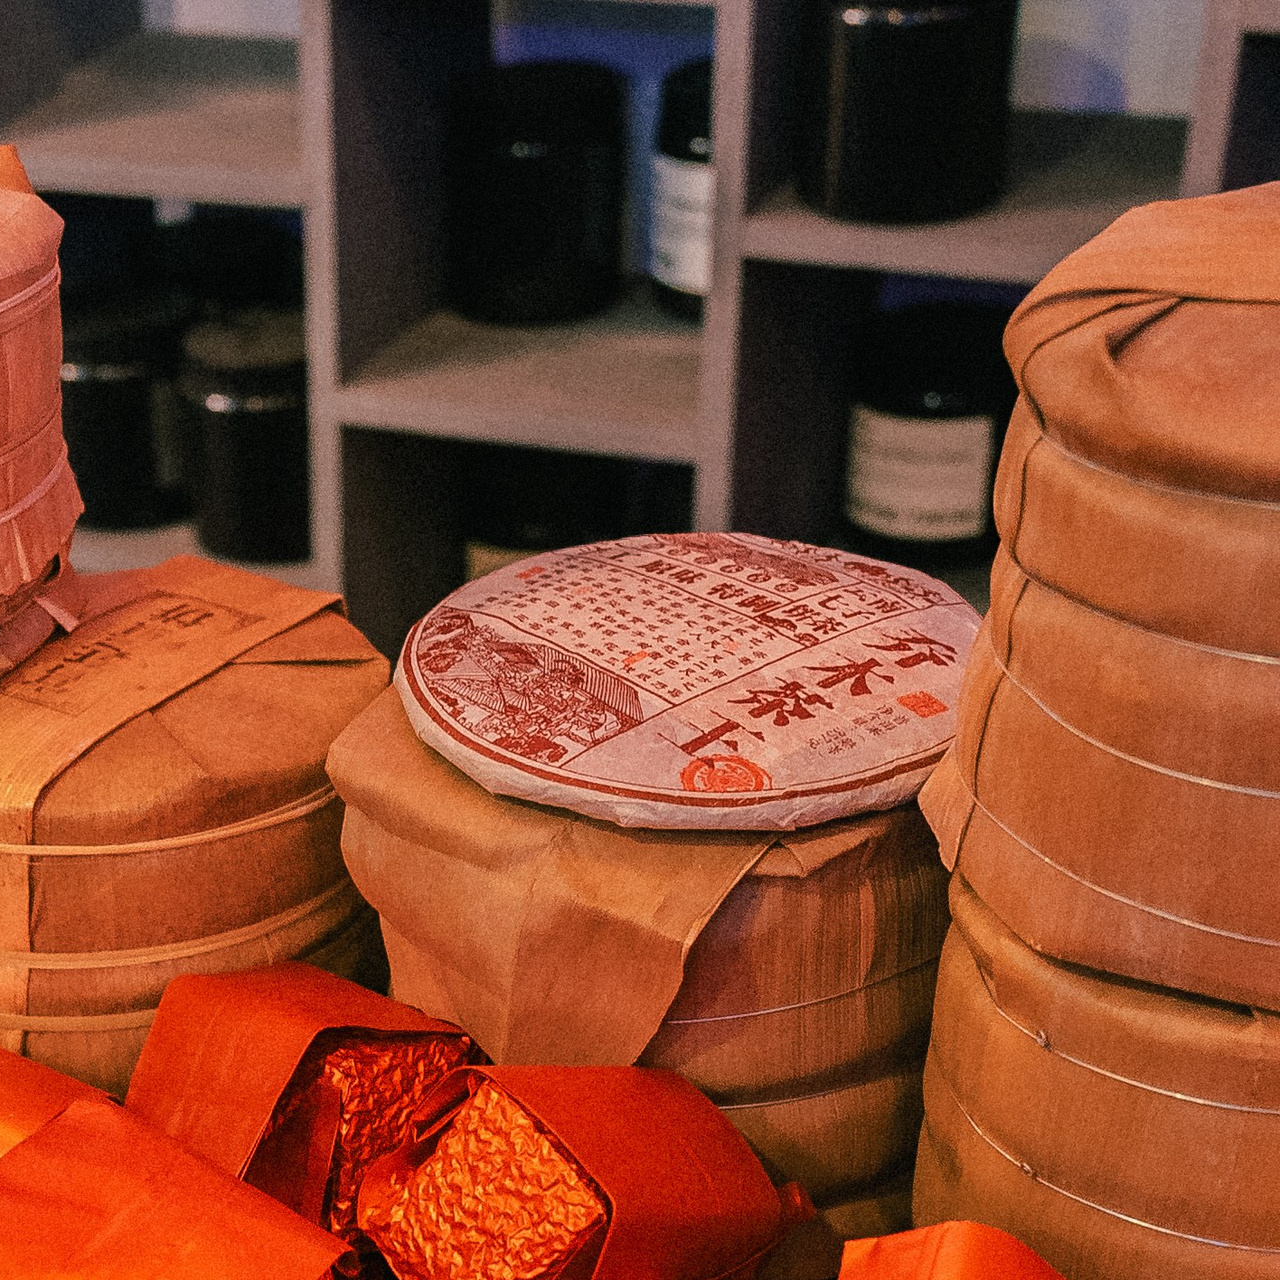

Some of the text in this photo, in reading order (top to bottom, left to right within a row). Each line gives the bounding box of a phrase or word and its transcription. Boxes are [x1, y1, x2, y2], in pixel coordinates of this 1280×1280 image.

[819, 595, 875, 620] 七子
[846, 588, 908, 614] 云南
[780, 604, 846, 634] 饼茶
[658, 627, 958, 763] 乔木茶王
